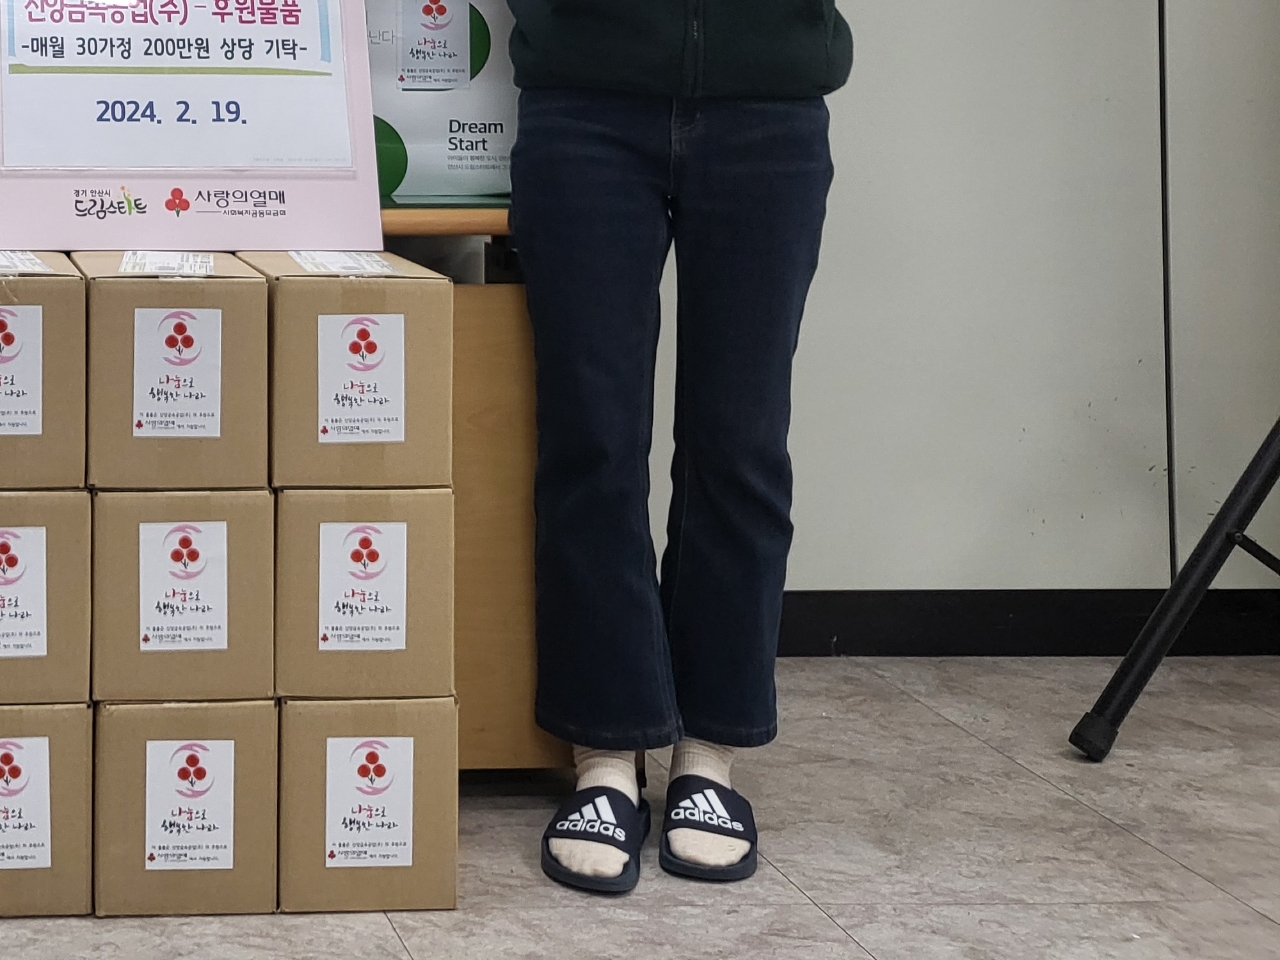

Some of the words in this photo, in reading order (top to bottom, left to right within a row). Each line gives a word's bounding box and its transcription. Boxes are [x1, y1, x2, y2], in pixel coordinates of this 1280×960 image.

[76, 37, 131, 59] 30가정
[143, 38, 210, 60] 200만원
[220, 38, 254, 60] 상당
[96, 100, 162, 124] 2024.
[176, 100, 197, 124] 2.
[211, 100, 247, 124] 19.
[449, 119, 504, 134] Dream
[448, 136, 488, 152] Start
[73, 189, 87, 197] 경기
[90, 189, 111, 197] 안산시
[195, 189, 286, 208] 사랑의열매
[556, 818, 626, 842] adidas
[671, 807, 744, 832] adidas
